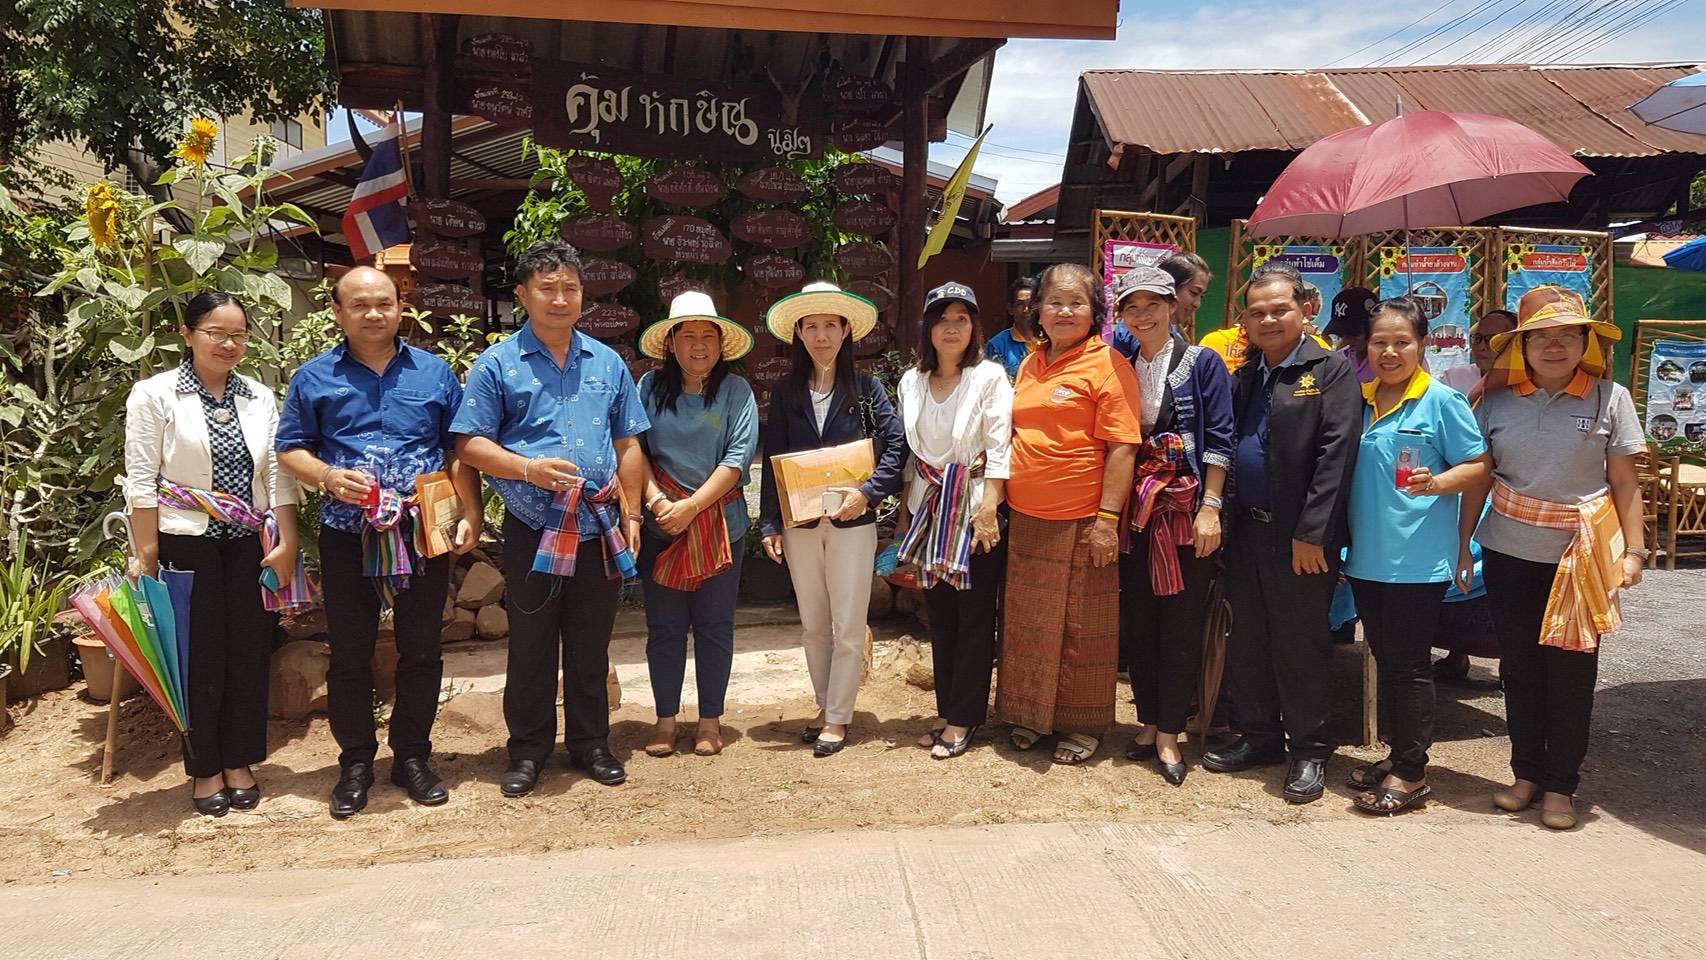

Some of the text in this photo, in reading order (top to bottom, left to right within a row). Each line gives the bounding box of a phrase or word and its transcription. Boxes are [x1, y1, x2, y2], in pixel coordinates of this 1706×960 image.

[566, 72, 632, 144] คุ้ม
[639, 90, 758, 145] ทักษิณ
[947, 287, 967, 297] CDD
[601, 309, 617, 317] 223
